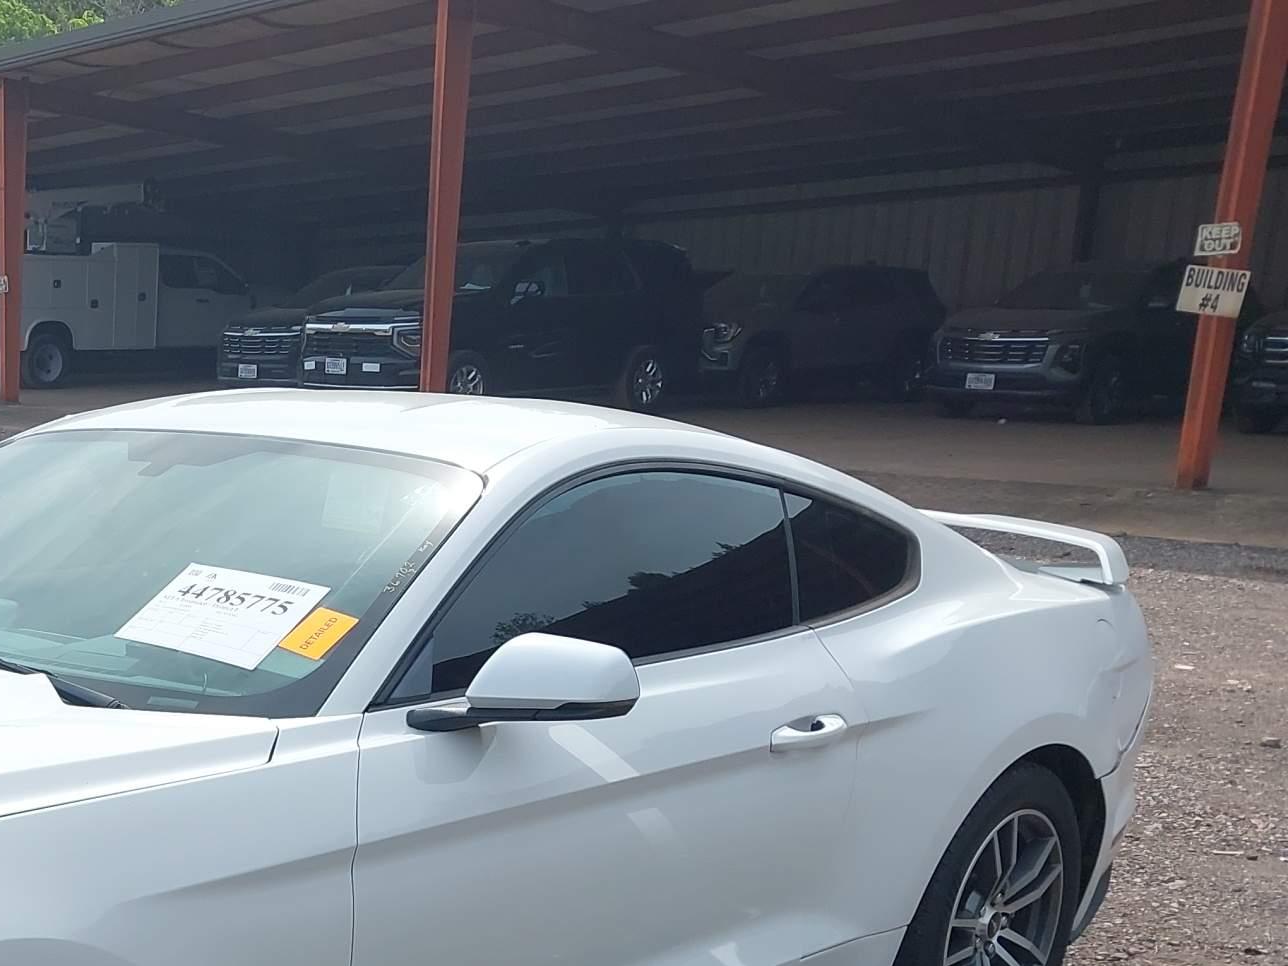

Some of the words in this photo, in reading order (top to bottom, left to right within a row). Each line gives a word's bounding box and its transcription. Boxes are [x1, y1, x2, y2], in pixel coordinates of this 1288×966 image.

[1202, 226, 1240, 239] KEEP
[1204, 239, 1232, 251] OUT
[1185, 268, 1247, 293] BUILDING
[1198, 293, 1221, 312] #4
[178, 582, 296, 616] 44785775
[299, 617, 338, 650] DETAILED
